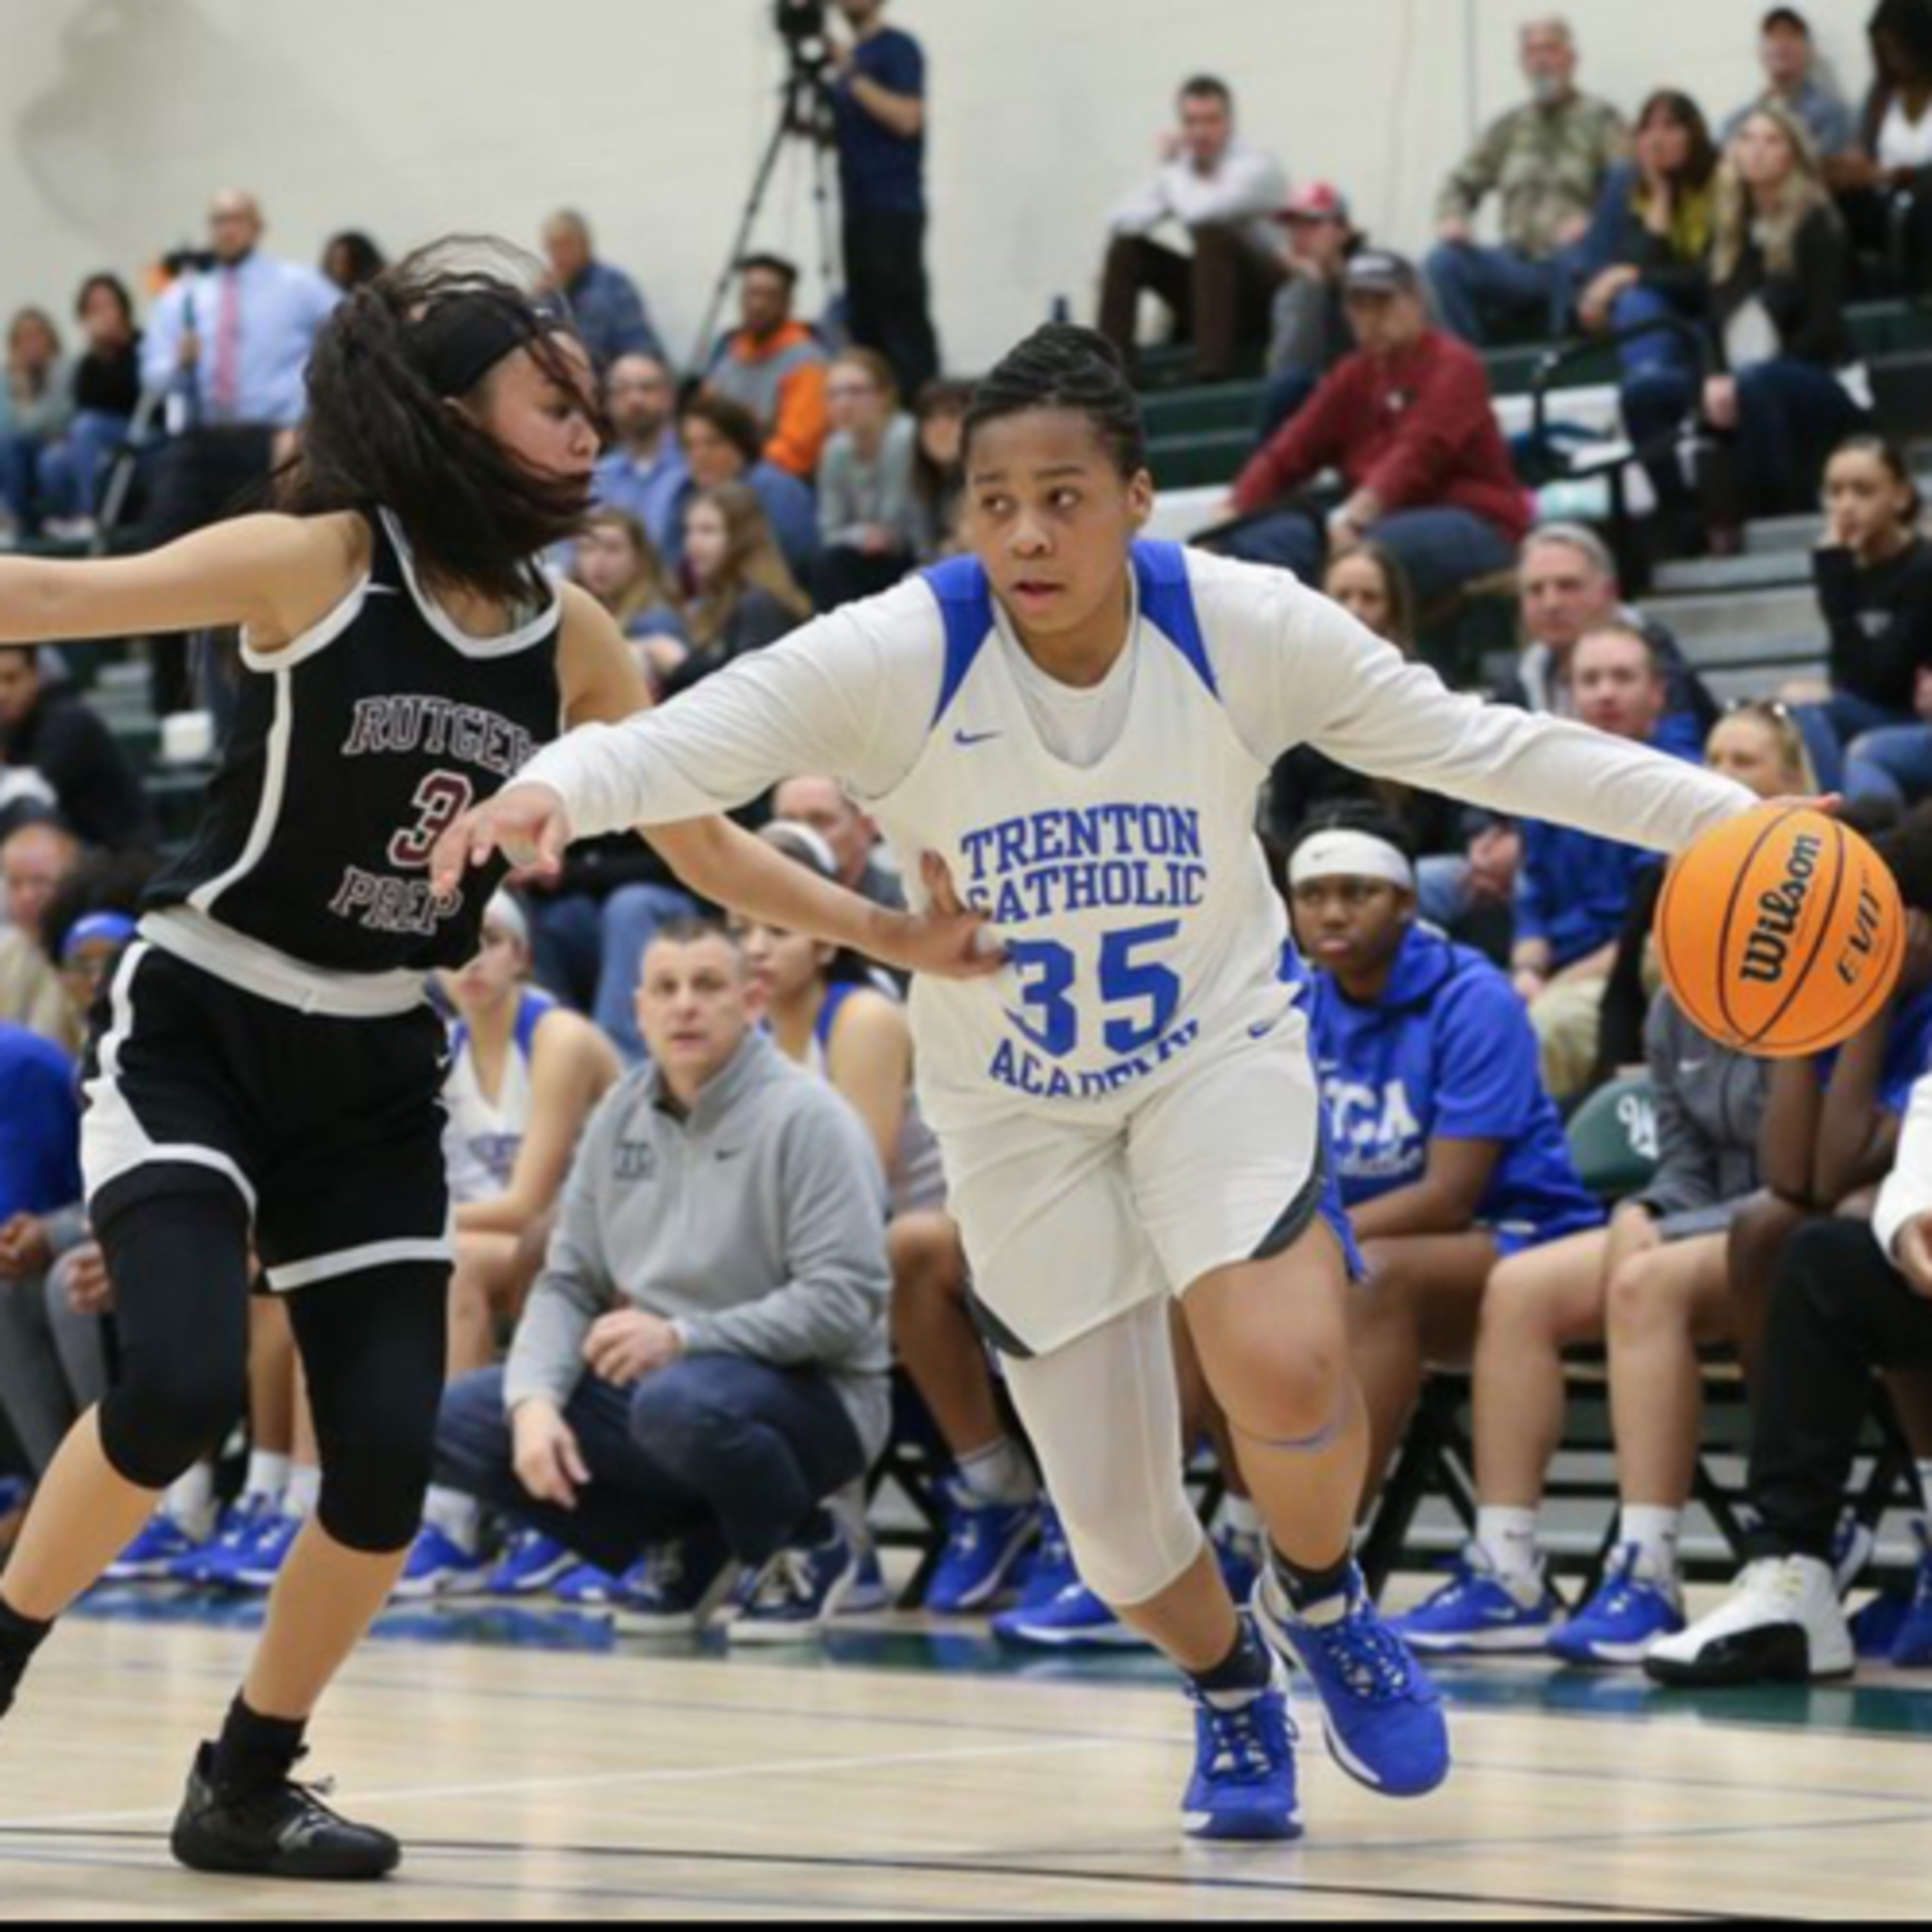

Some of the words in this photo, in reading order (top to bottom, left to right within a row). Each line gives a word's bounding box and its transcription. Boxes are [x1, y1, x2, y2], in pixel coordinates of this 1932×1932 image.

[340, 695, 544, 781] RUTGER
[386, 768, 474, 867] 3
[960, 802, 1202, 882] TRENTON
[328, 865, 462, 936] PREP
[966, 860, 1208, 925] CATHOLIC
[1740, 834, 1821, 983] Wilson
[1002, 918, 1181, 1058] 35
